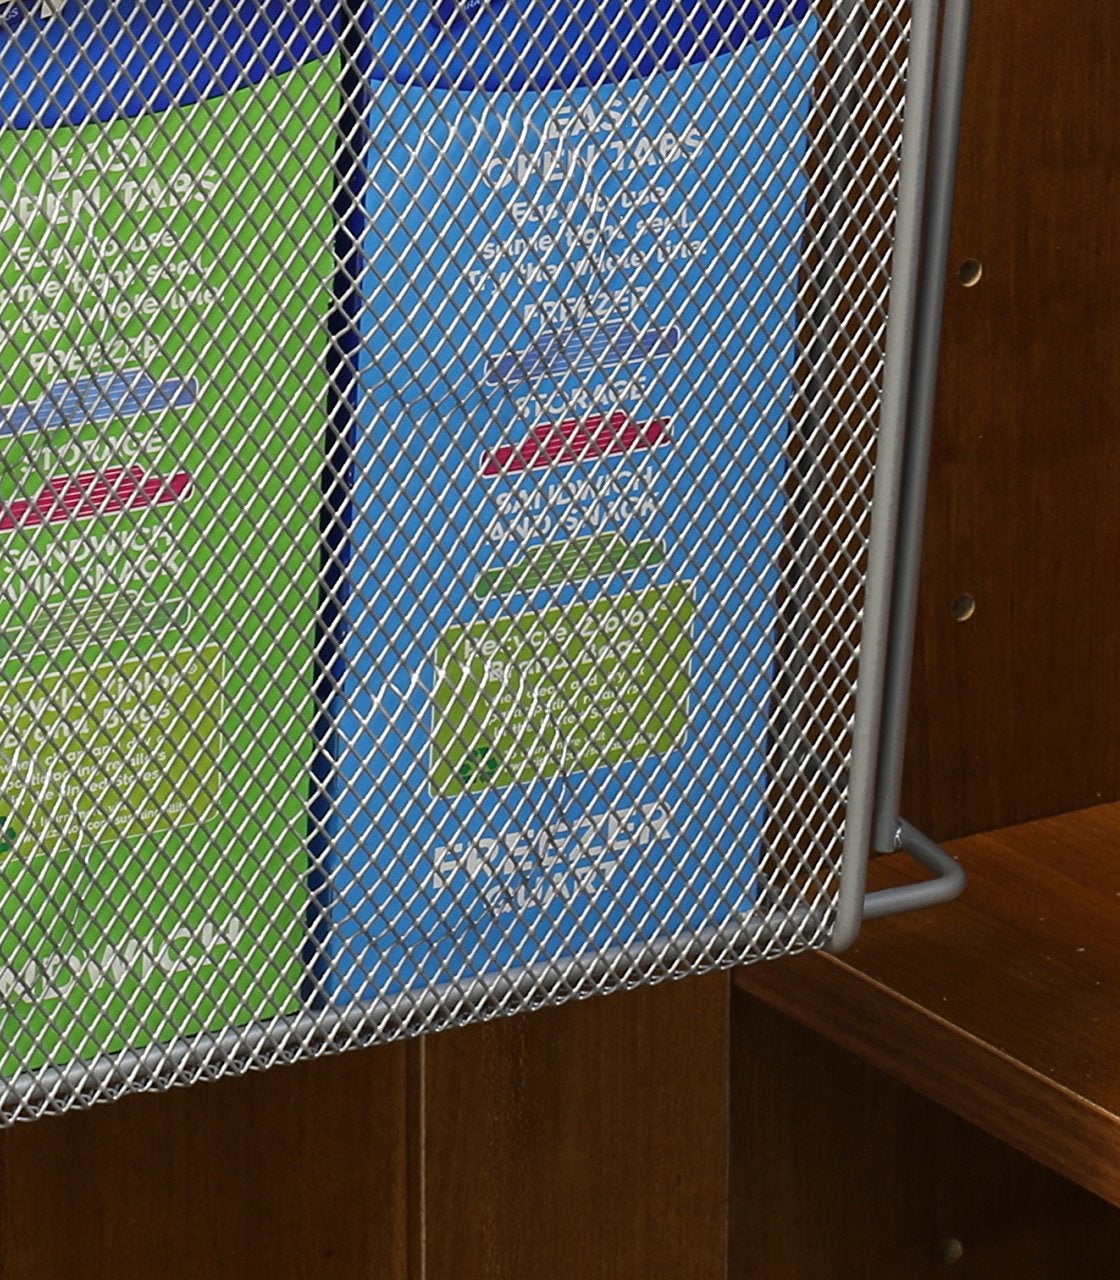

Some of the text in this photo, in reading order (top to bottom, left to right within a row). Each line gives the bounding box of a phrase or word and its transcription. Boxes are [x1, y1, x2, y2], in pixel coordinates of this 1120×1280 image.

[522, 285, 648, 325] FREEZER
[29, 333, 164, 375] FREEZER
[514, 375, 647, 420] STORAGE
[20, 431, 164, 475] STORAGE
[495, 465, 654, 517] SANDWICH
[3, 523, 174, 574] SANDWICH
[432, 800, 672, 891] FREEZER
